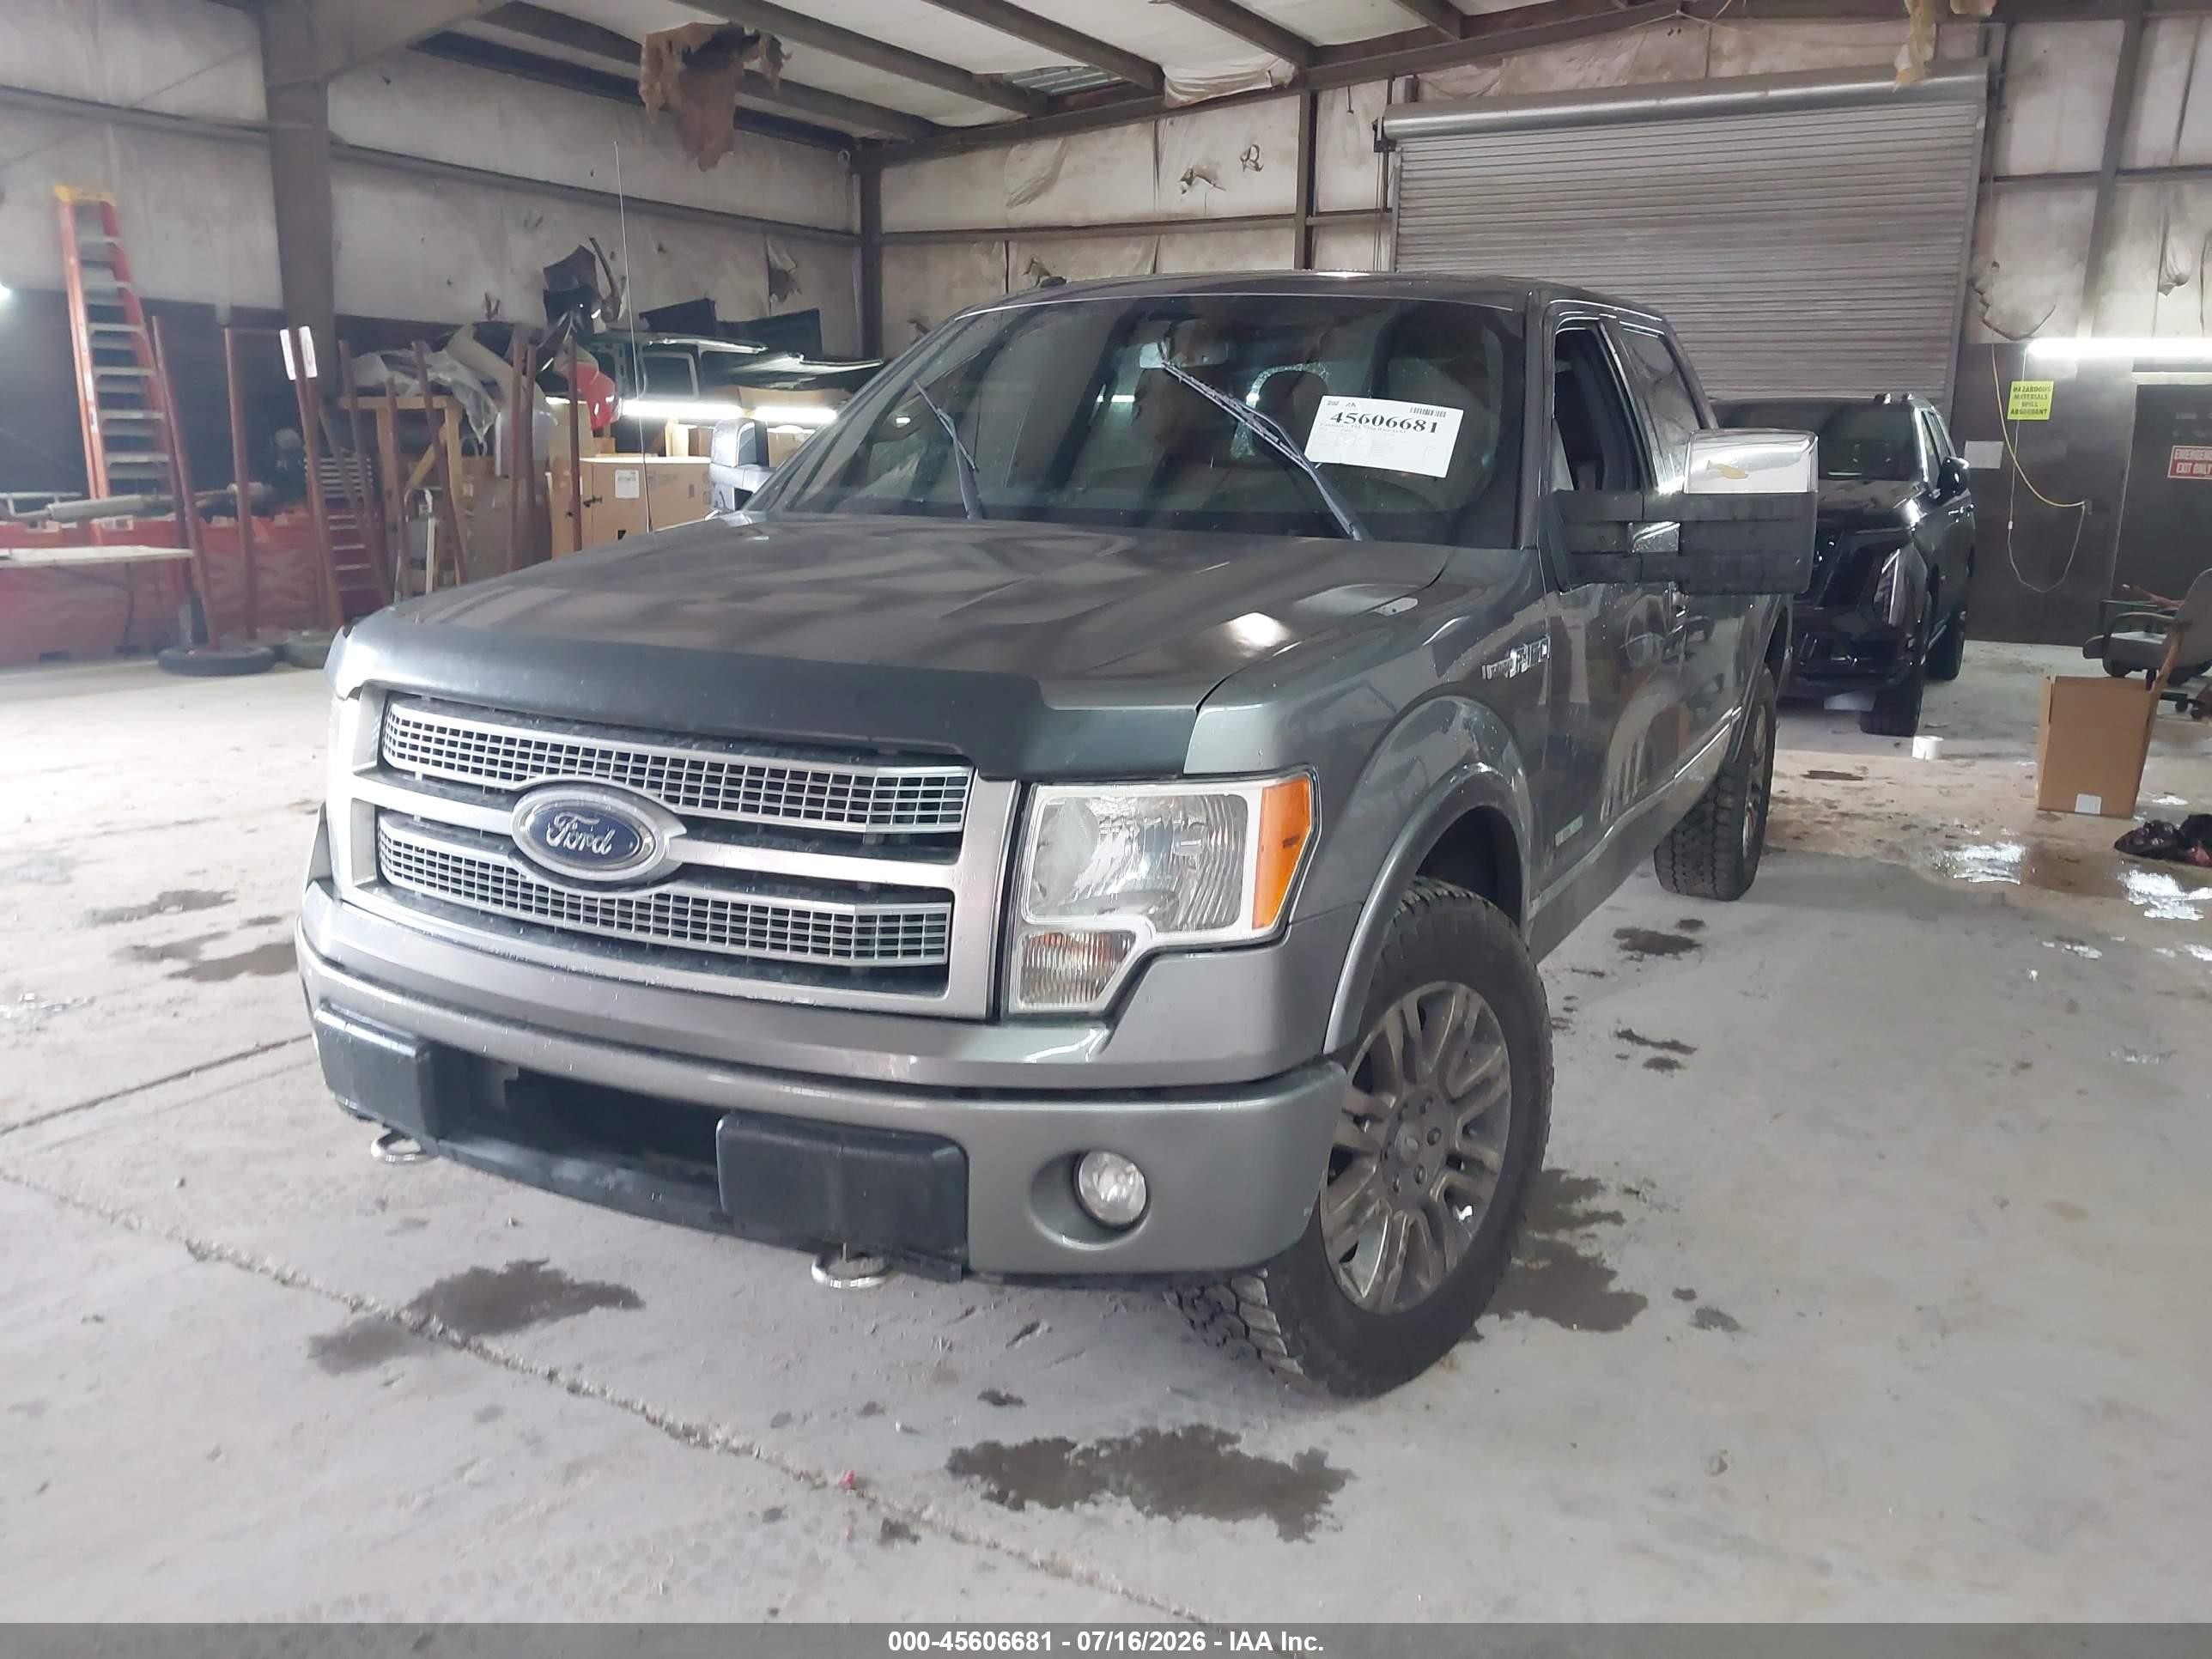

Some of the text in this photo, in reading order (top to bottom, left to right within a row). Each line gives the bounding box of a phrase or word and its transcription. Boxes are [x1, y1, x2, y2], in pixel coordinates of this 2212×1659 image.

[1330, 412, 1438, 433] 45606681
[2176, 462, 2193, 474] EXIT
[546, 811, 616, 854] Ford
